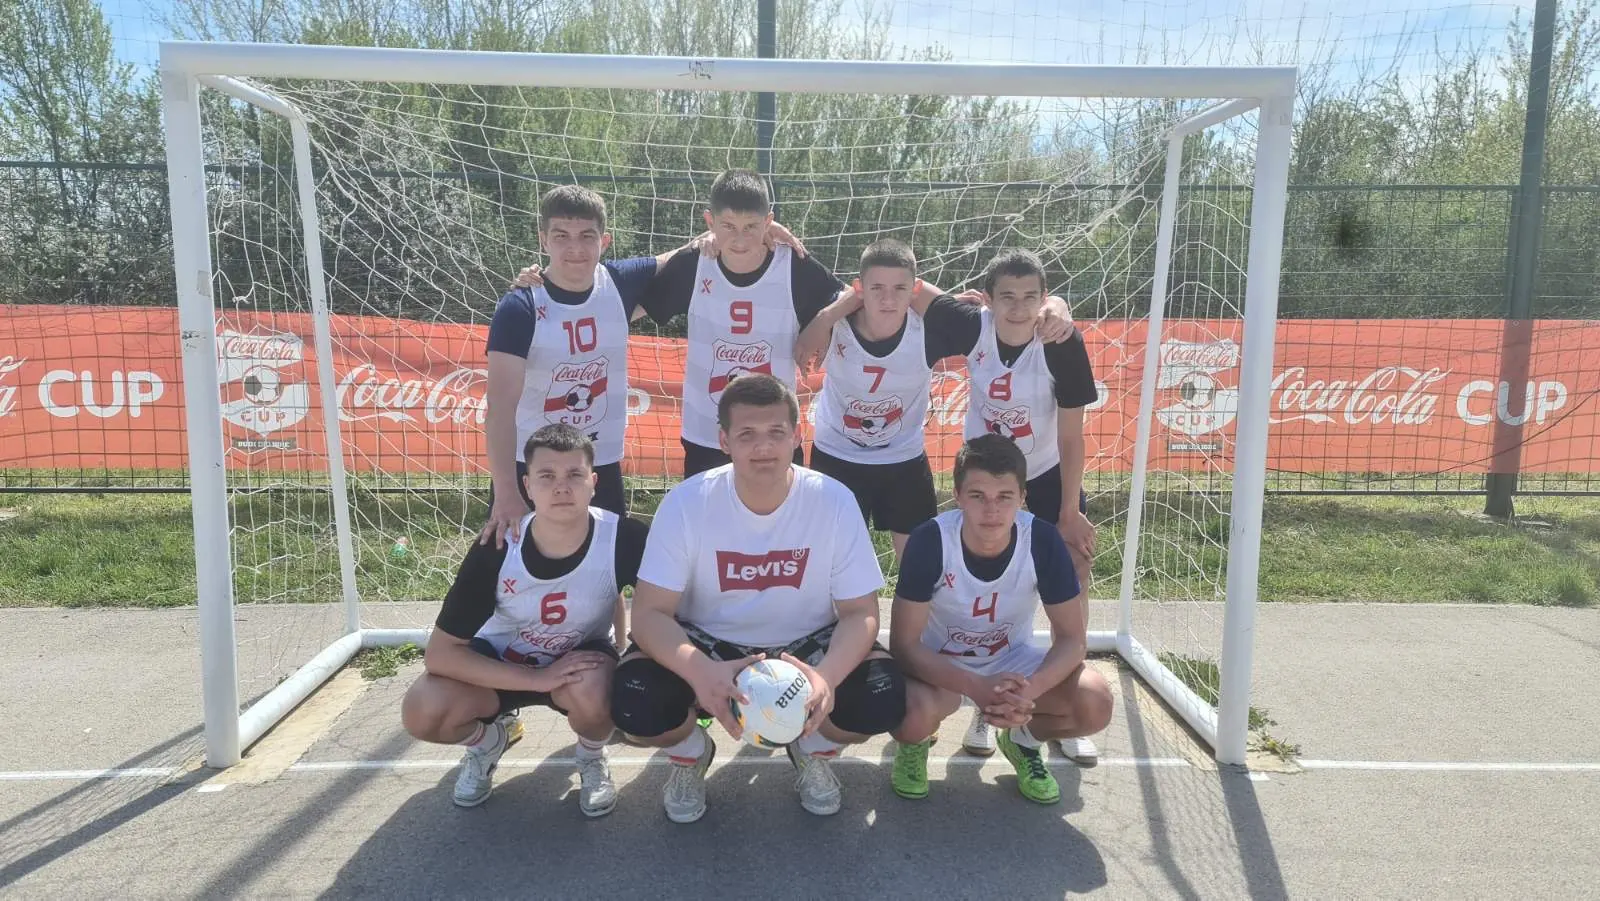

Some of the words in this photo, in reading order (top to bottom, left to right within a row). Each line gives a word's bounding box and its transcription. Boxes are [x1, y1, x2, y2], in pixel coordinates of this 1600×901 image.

[730, 300, 753, 334] 9
[562, 317, 597, 355] 10
[38, 369, 164, 418] CUP
[335, 363, 488, 424] Coca-Co
[863, 365, 887, 394] 7
[989, 371, 1012, 402] 8
[240, 409, 286, 423] CUP
[560, 415, 592, 425] CUP
[1456, 380, 1567, 426] CUP
[540, 591, 567, 626] 6
[972, 592, 999, 624] 4
